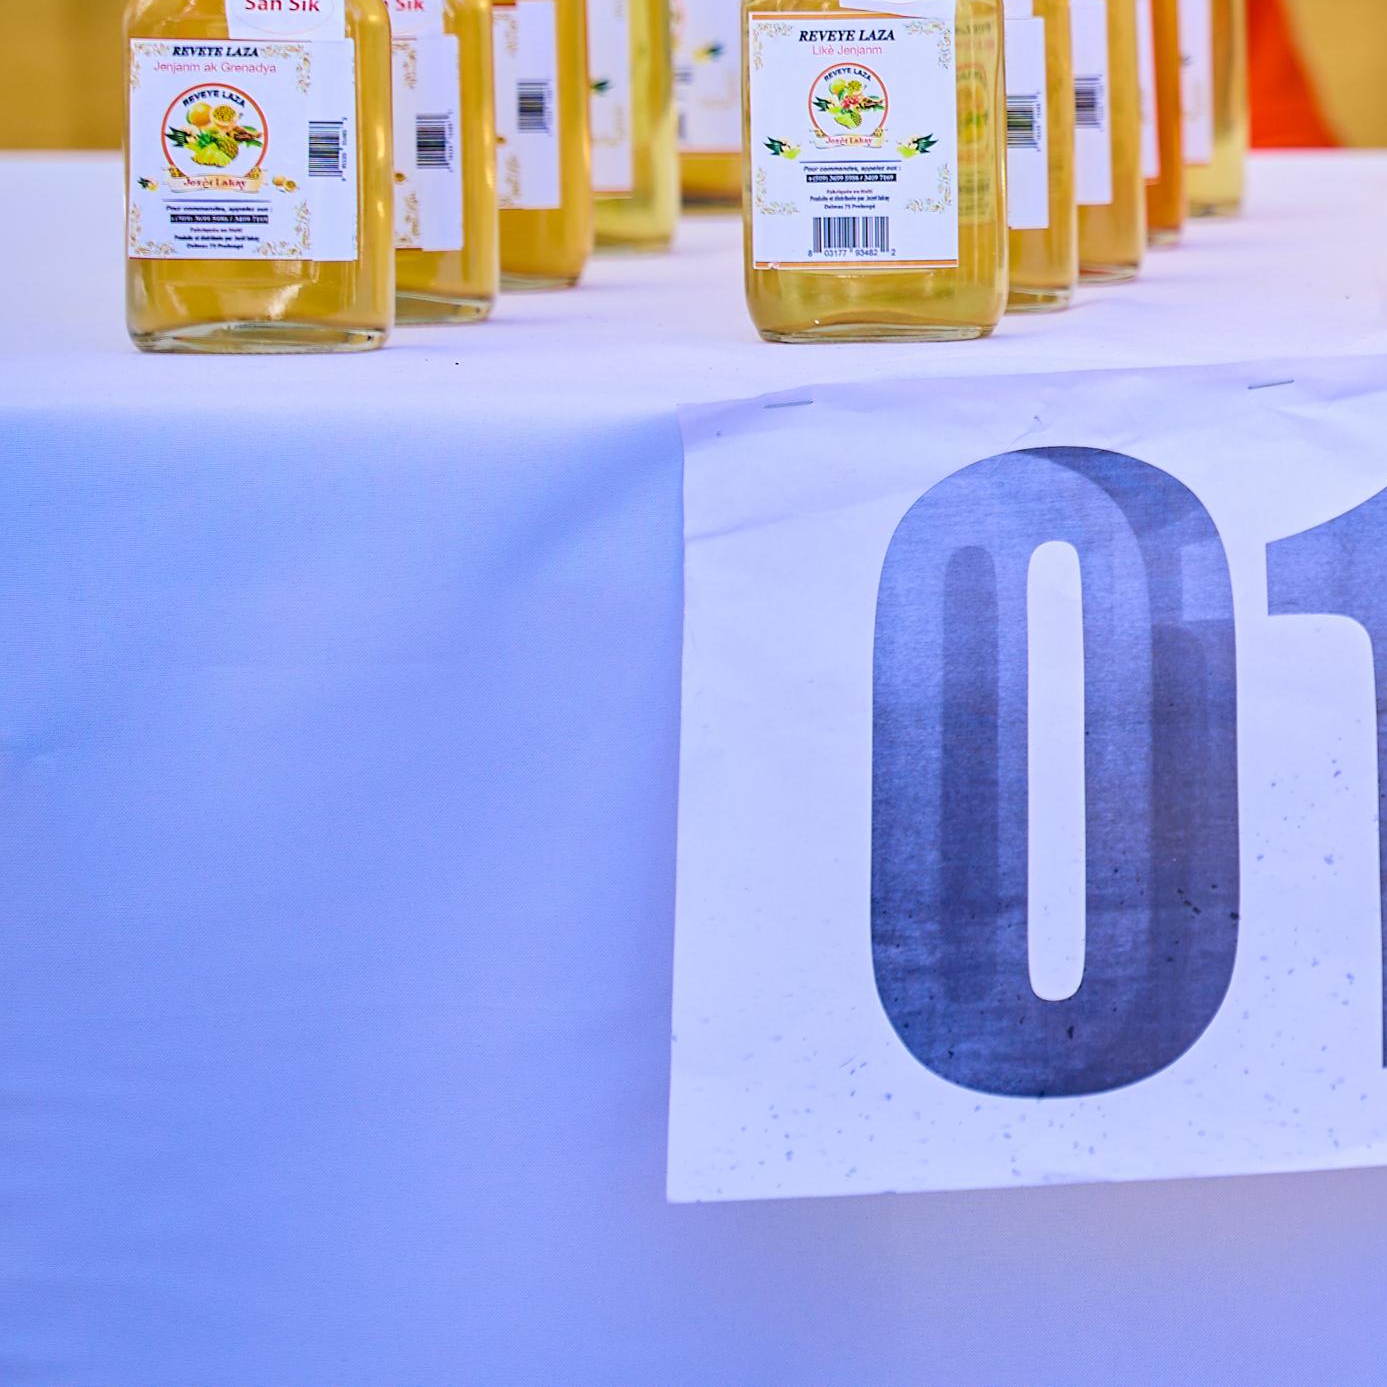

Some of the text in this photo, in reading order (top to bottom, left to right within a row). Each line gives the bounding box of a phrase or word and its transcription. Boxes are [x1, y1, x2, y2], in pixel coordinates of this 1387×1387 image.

[799, 30, 895, 42] REVEYE LAZA
[172, 46, 259, 57] REVEYE LAZA
[812, 46, 882, 56] Likè Jenjanm
[154, 62, 277, 75] Jenjanm ak Grenadya
[824, 68, 871, 82] REVEYE LAZA
[182, 90, 245, 107] REVEYE LAZA
